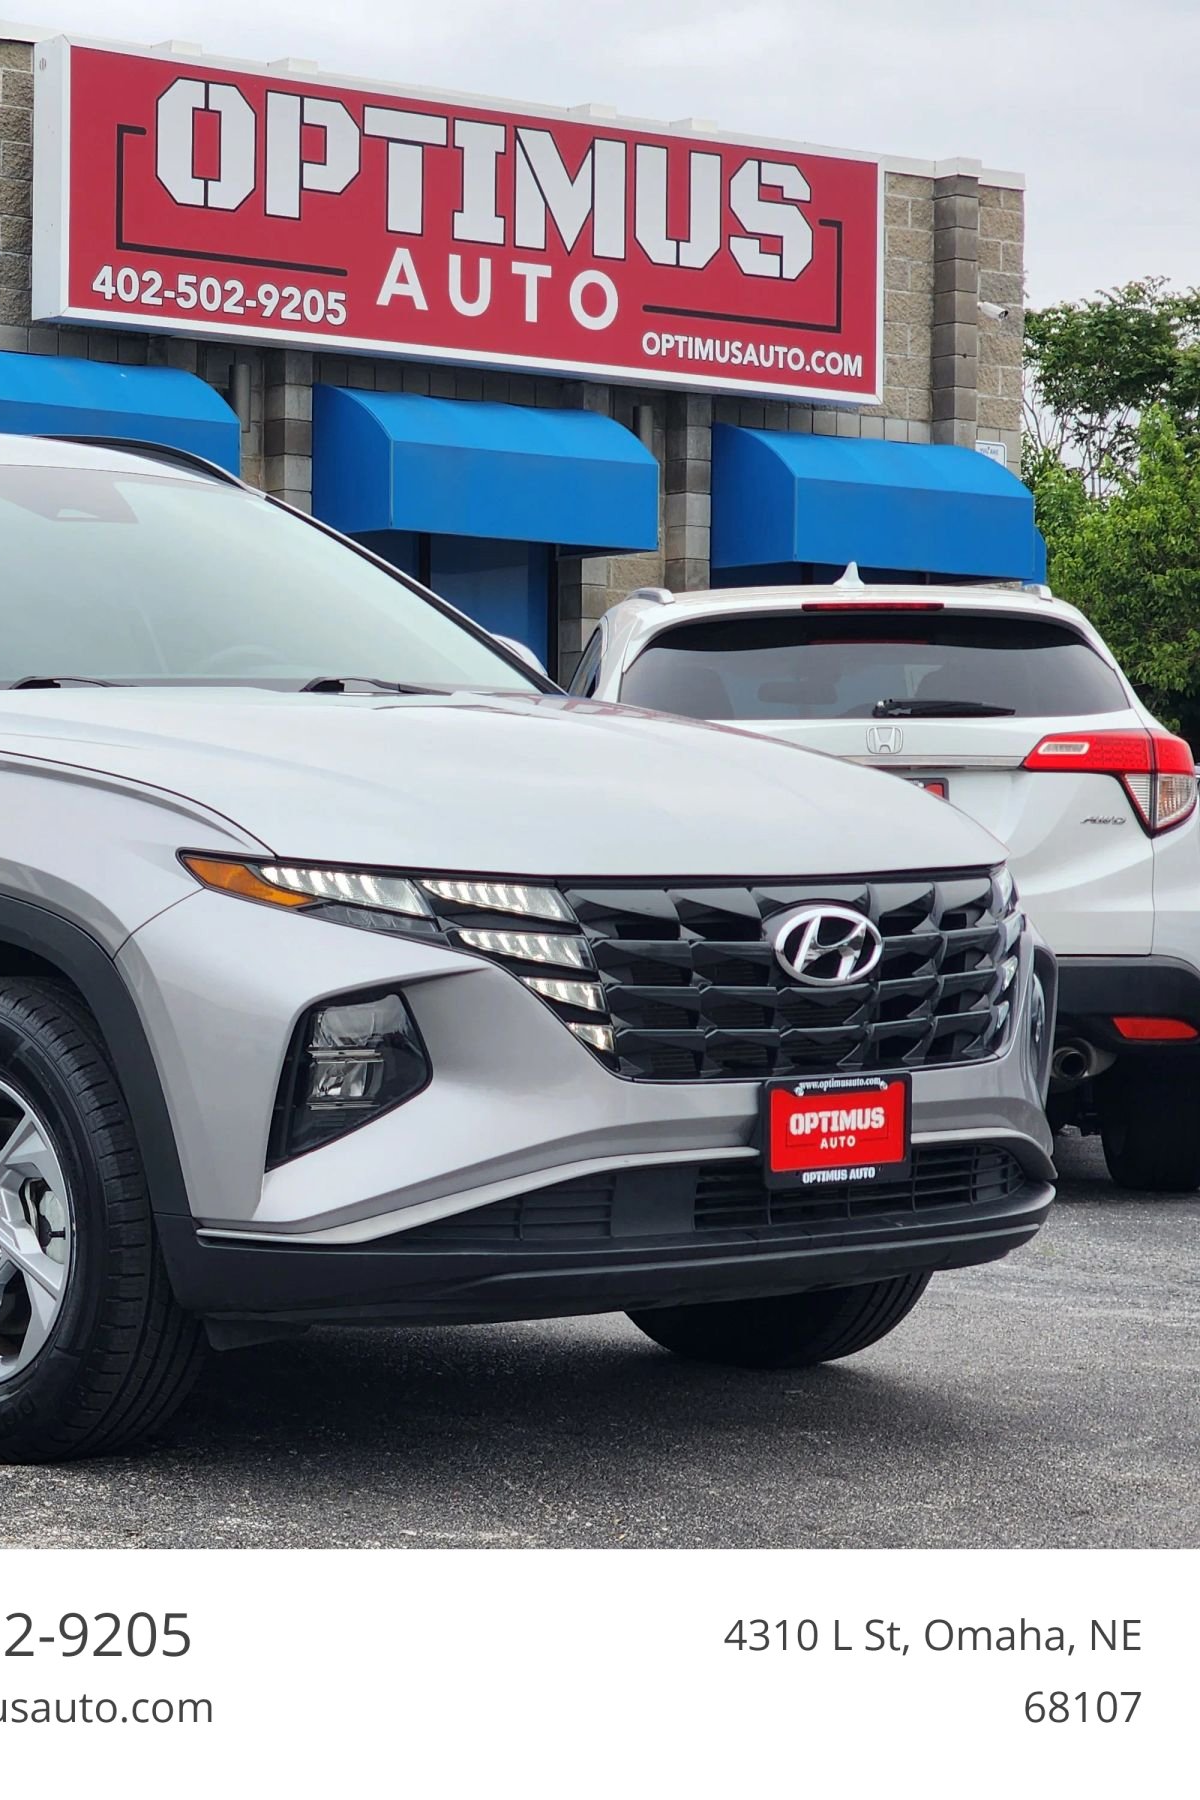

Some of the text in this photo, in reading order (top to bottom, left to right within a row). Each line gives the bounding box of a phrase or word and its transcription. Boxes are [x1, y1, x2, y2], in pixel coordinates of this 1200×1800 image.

[155, 77, 814, 281] OPTIMUS
[91, 264, 348, 326] 402-502-9205
[375, 247, 619, 331] AUTO
[641, 331, 863, 378] OPTIMUSAUTO.COM
[799, 1077, 881, 1091] www.optimusauto.com
[789, 1106, 885, 1135] OPTIMUS
[820, 1135, 856, 1149] AUTO
[802, 1167, 876, 1184] OPTIMUS AUTO
